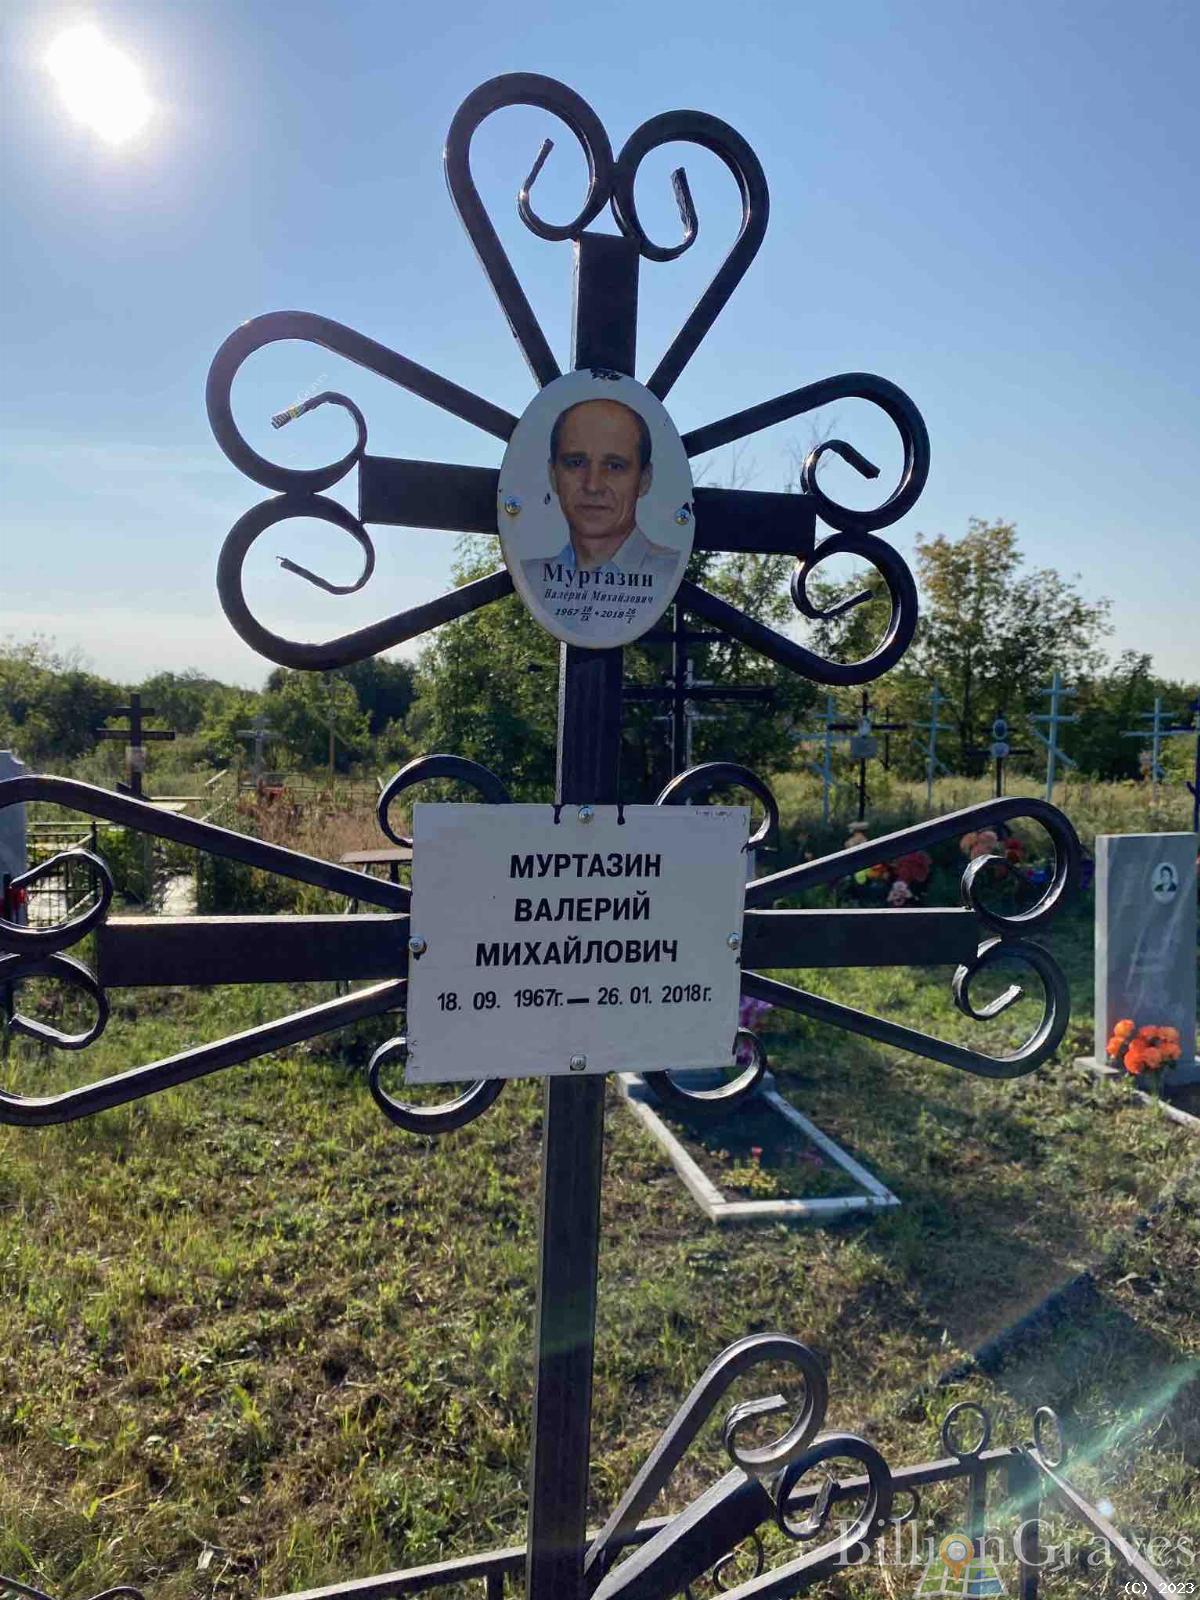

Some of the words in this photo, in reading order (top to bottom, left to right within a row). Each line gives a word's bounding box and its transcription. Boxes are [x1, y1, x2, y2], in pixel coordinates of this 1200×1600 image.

[543, 563, 653, 588] Муртазин
[544, 588, 588, 602] Валерий
[591, 590, 654, 604] Михайлович
[601, 609, 624, 619] 2018
[510, 853, 662, 879] МУРТАЗИН
[514, 890, 650, 922] ВАЛЕРИЙ
[476, 936, 678, 967] МИХАЙЛОВИЧ
[437, 992, 462, 1012] 18.
[473, 990, 501, 1011] 09.
[597, 986, 623, 1006] 26.
[630, 985, 653, 1005] 01.
[661, 983, 712, 1004] 2018г.
